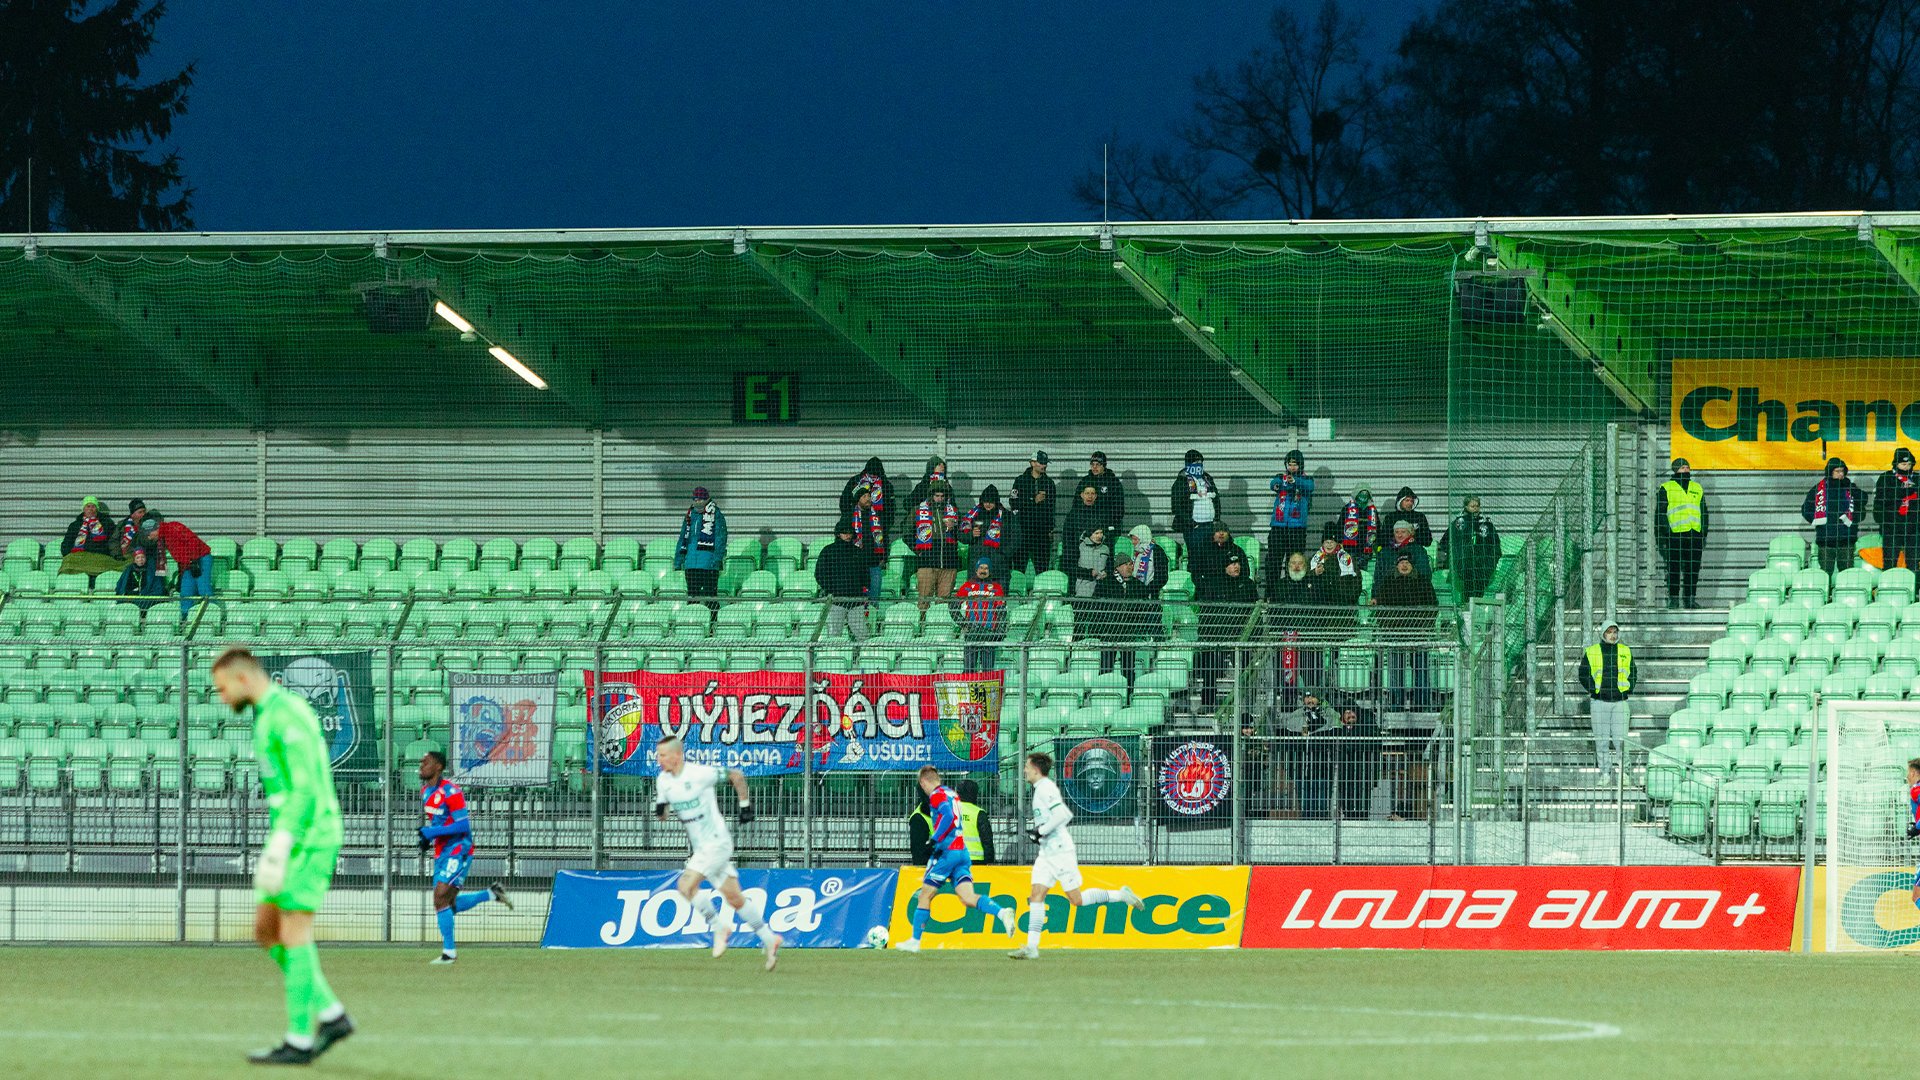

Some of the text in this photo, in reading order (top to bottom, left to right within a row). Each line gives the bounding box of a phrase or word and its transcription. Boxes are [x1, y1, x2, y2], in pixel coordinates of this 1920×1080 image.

[745, 375, 789, 419] E1
[727, 748, 782, 767] DOMA
[907, 882, 1231, 934] Chance
